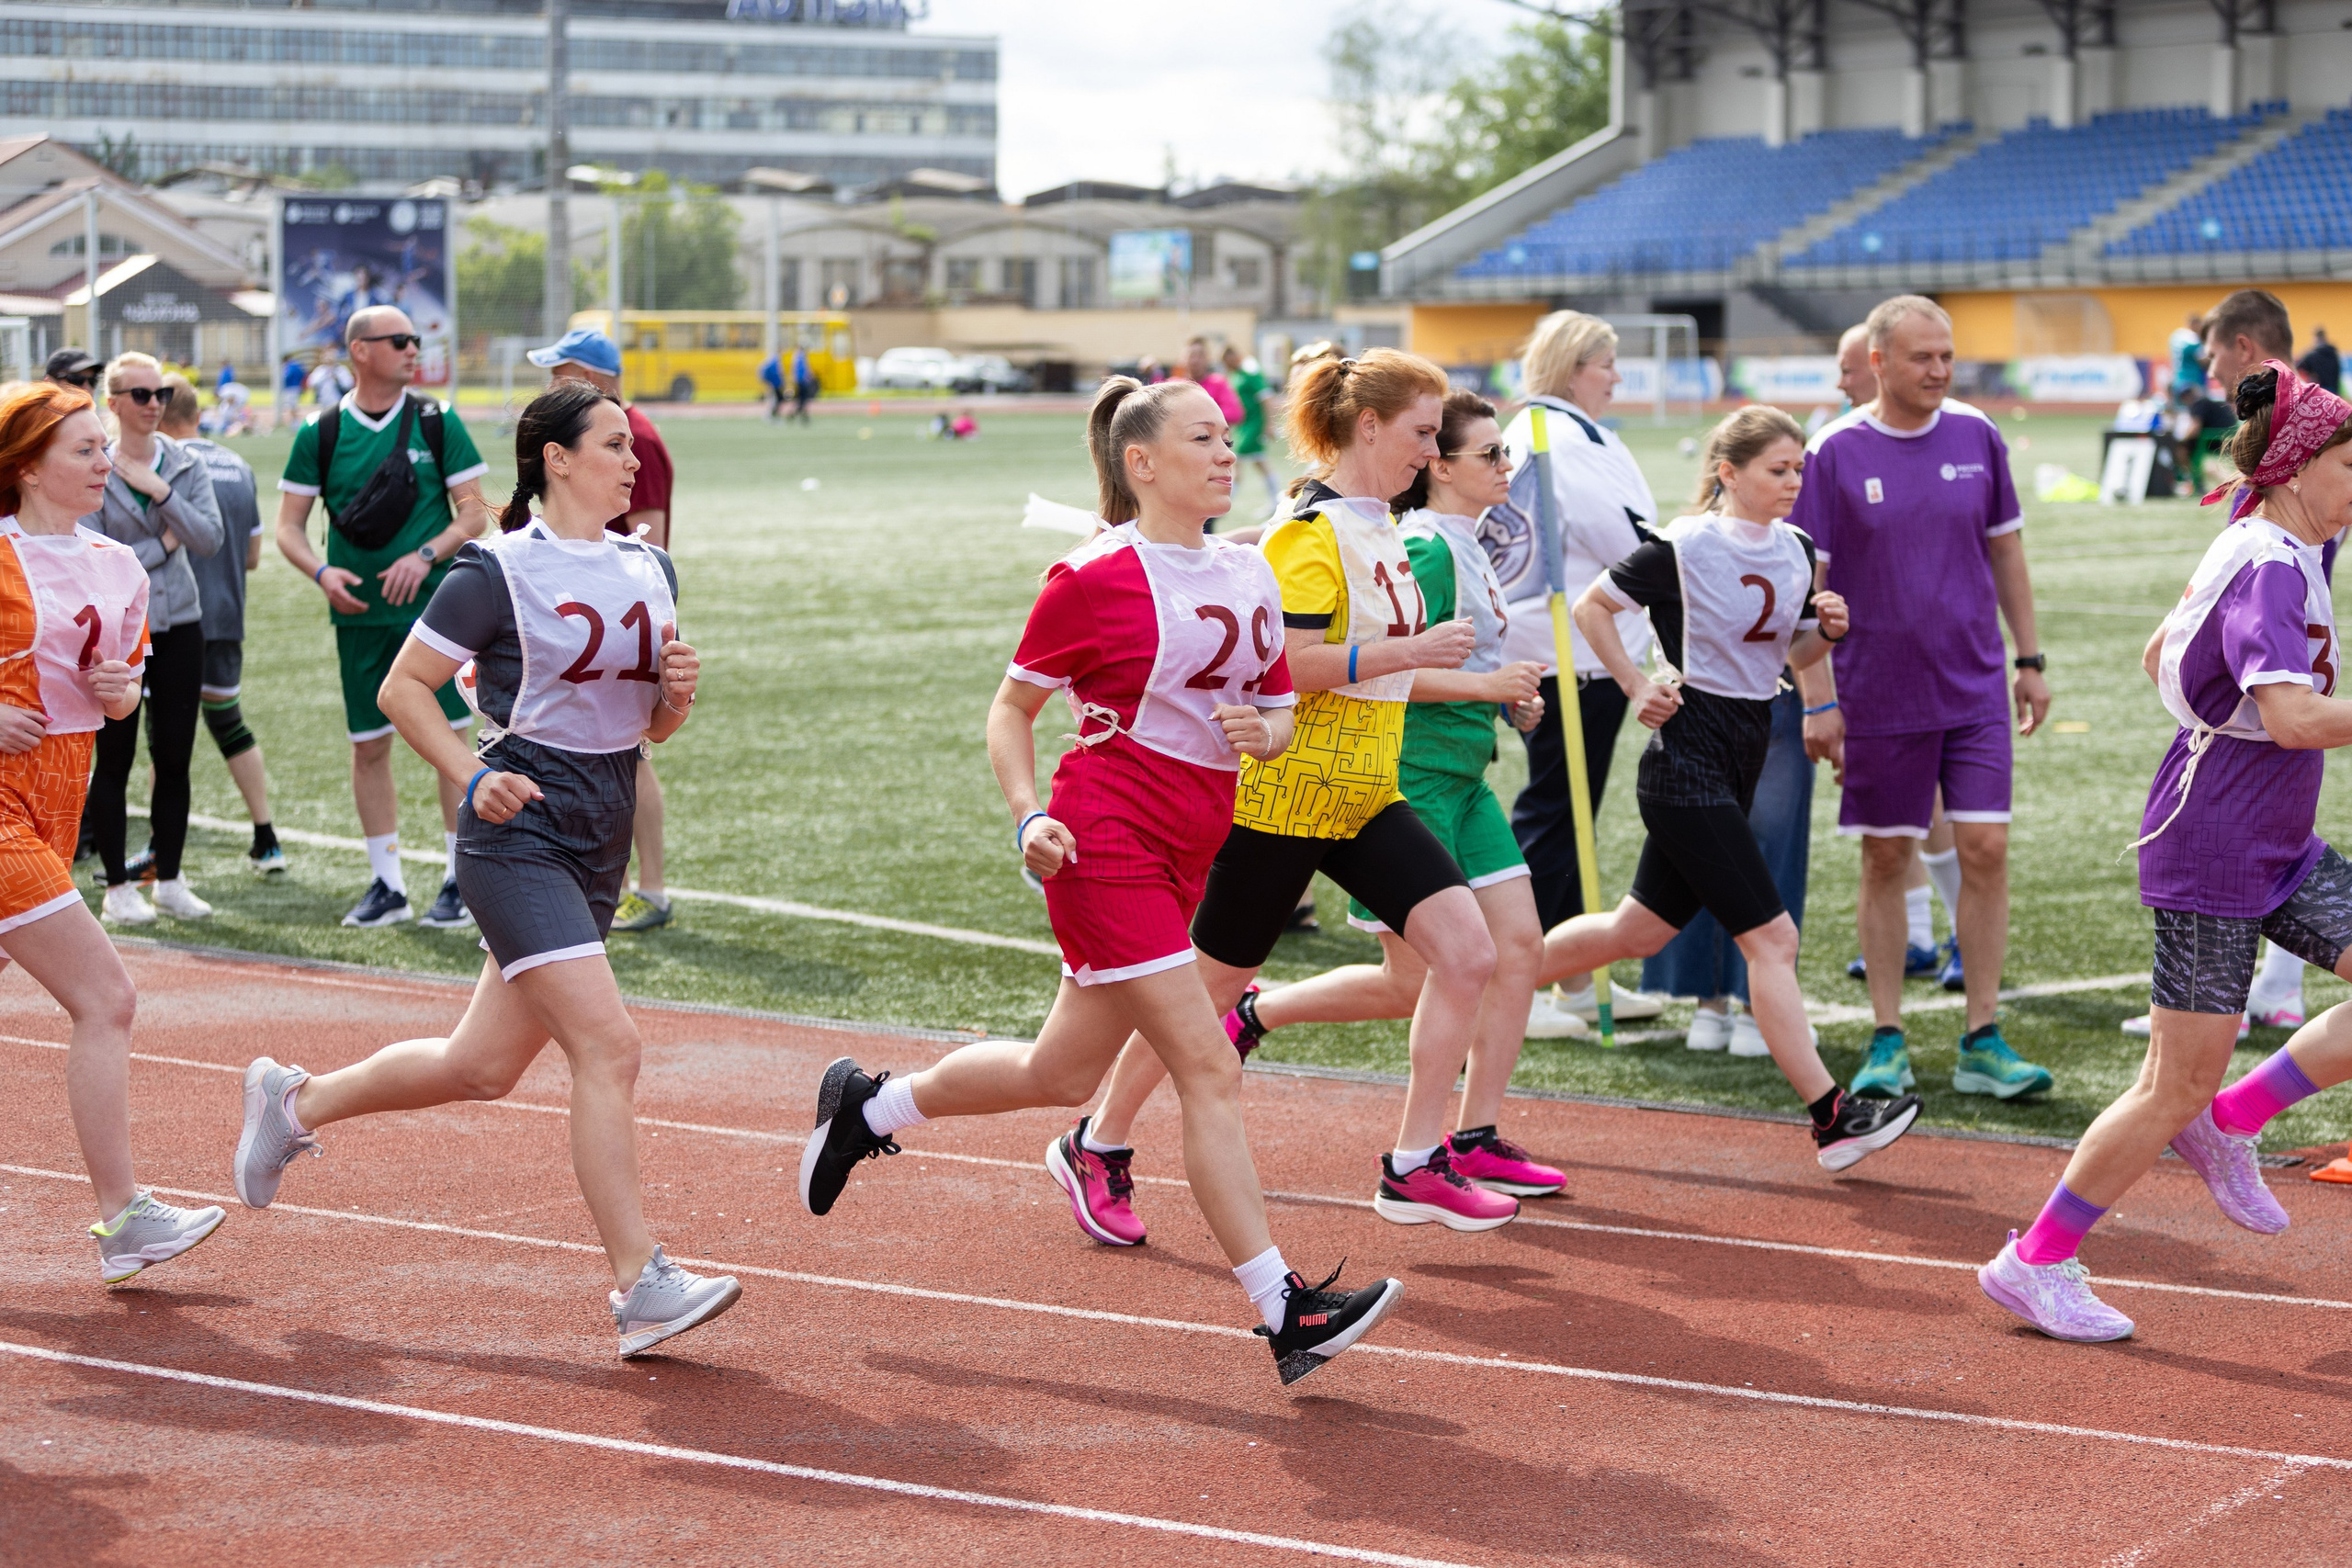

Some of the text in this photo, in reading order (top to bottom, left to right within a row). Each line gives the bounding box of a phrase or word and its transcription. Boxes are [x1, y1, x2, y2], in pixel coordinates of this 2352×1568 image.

[554, 601, 661, 684] 21
[1740, 574, 1778, 642] 2
[1184, 604, 1273, 692] 29
[1299, 1313, 1328, 1327] PUMA
